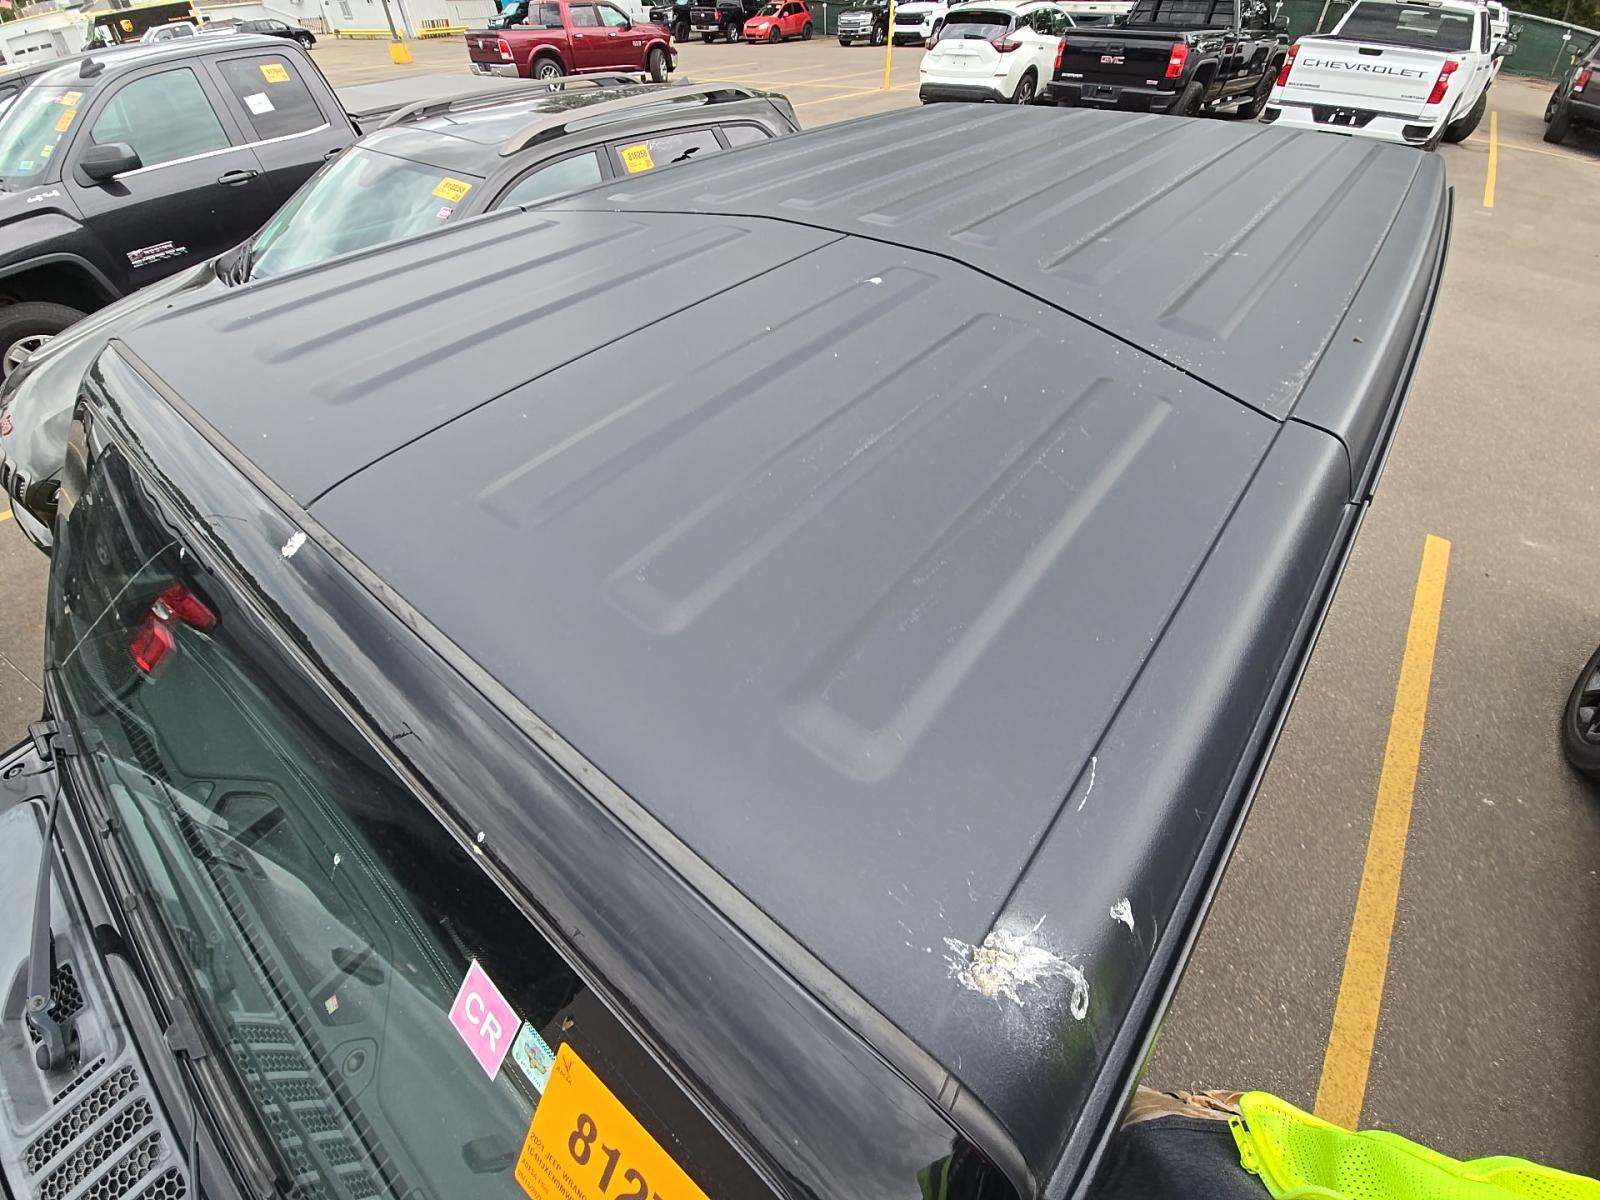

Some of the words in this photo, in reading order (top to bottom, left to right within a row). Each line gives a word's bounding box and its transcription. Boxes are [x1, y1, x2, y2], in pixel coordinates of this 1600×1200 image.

[1101, 55, 1125, 65] GMC
[1302, 57, 1429, 79] CHEVROLET
[465, 991, 503, 1055] CR
[545, 1152, 562, 1171] JEEP
[568, 1113, 663, 1200] 812
